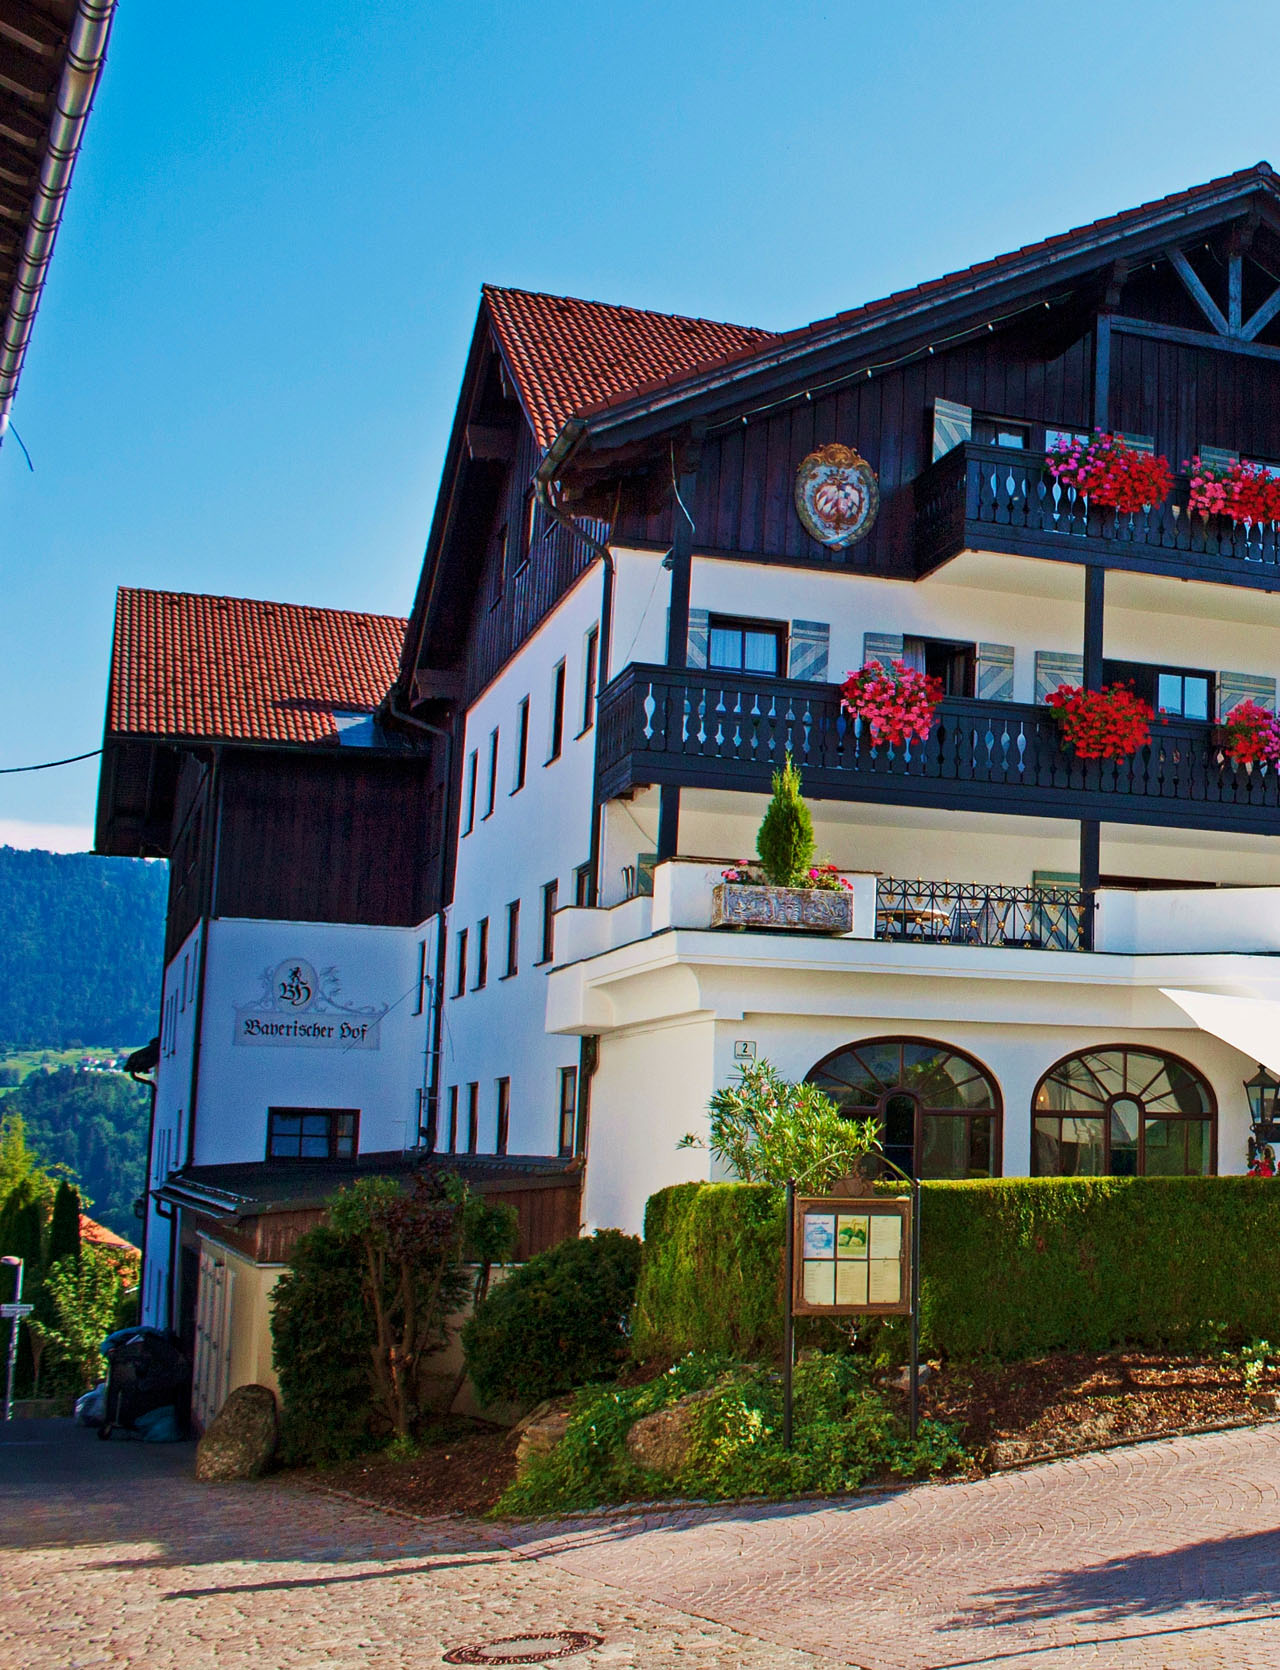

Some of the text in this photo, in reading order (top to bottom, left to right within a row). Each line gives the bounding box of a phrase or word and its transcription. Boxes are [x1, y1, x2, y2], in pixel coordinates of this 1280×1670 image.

[244, 1018, 369, 1042] Bayerischer Hof
[742, 1042, 748, 1054] 2
